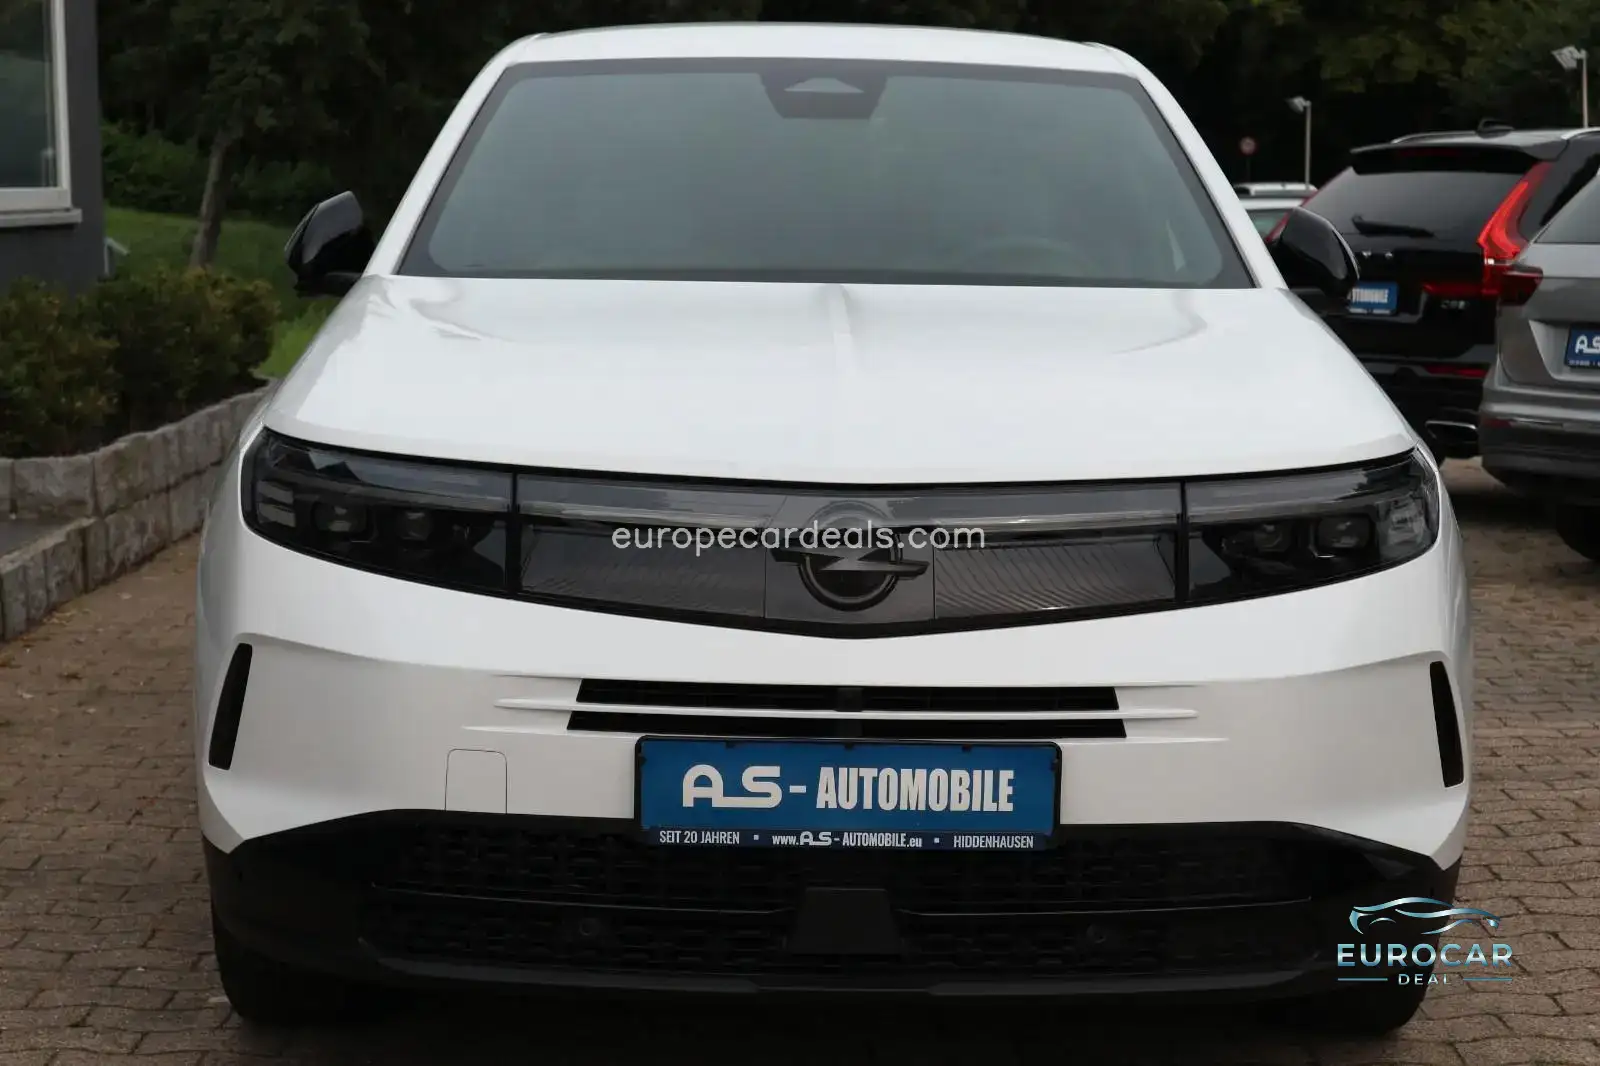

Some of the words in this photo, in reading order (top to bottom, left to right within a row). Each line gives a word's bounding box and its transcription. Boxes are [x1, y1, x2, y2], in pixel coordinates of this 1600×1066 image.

[659, 830, 681, 844] SEIT
[683, 831, 698, 844] 20
[700, 831, 740, 845] JAHREN
[953, 835, 1034, 849] HIDDENHAUSEN
